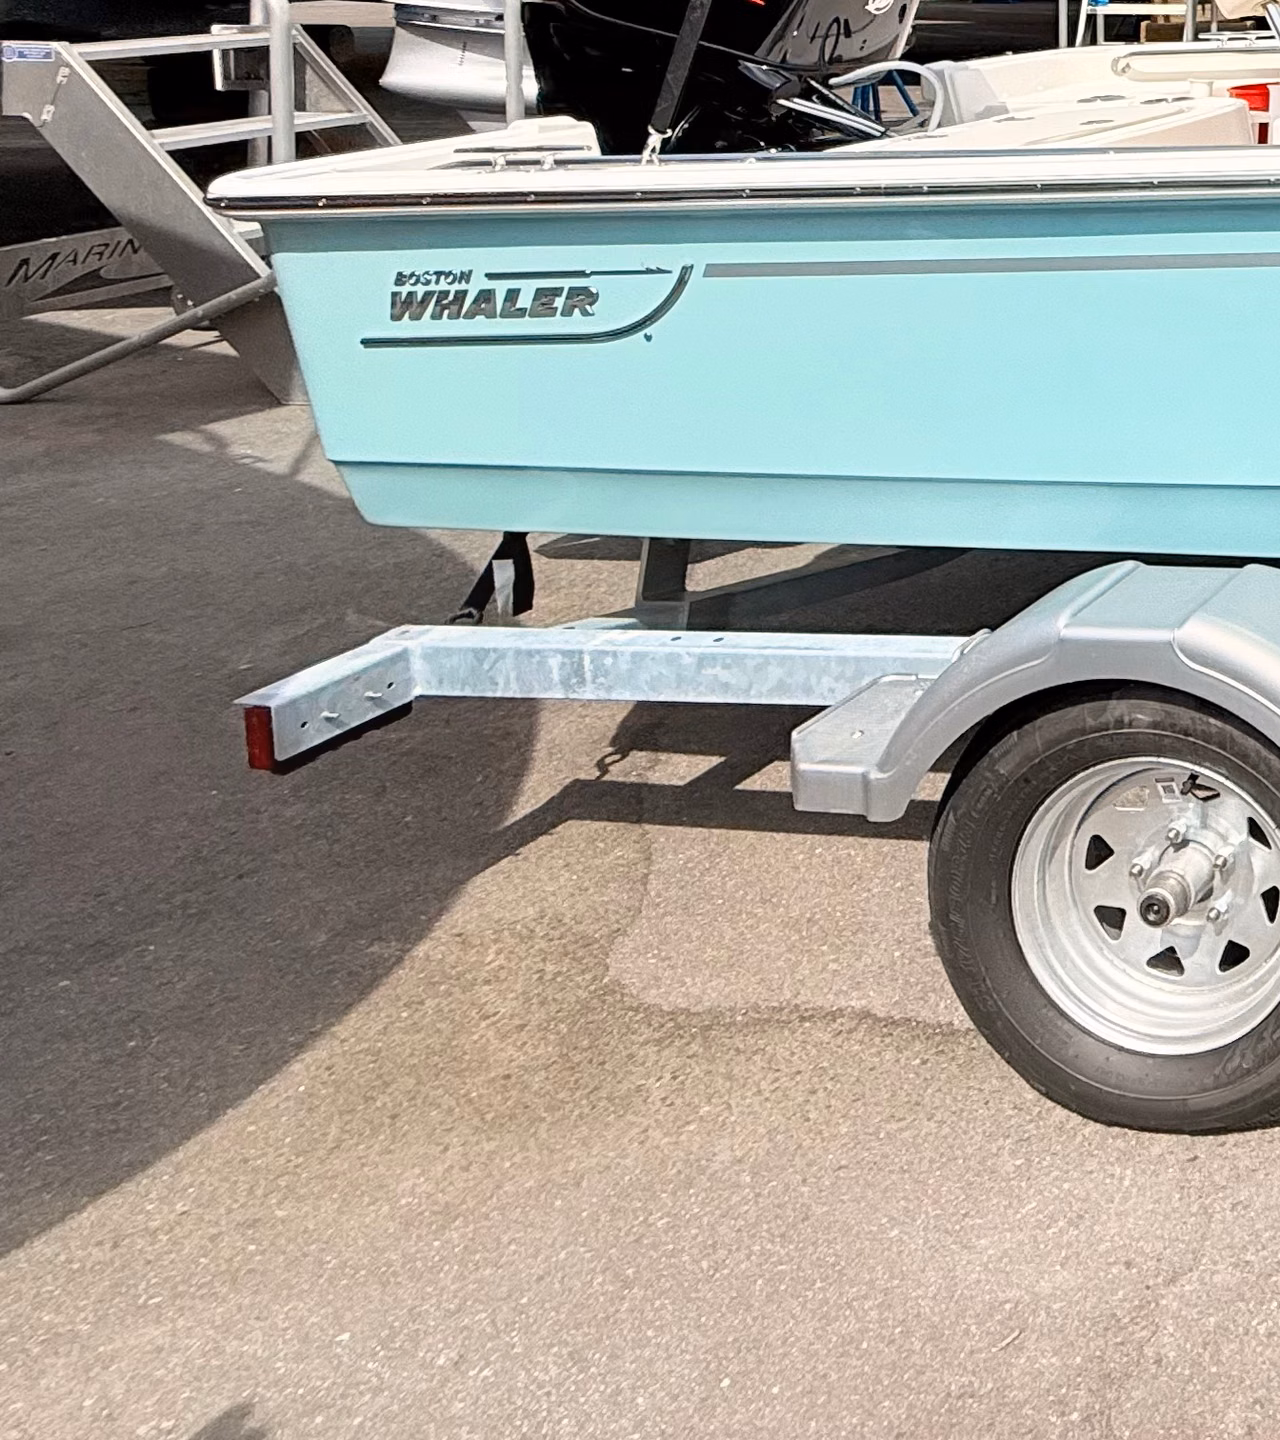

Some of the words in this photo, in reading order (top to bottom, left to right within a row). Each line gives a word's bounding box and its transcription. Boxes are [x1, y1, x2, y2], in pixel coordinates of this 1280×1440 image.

[5, 238, 142, 288] MARIN
[393, 269, 474, 287] BOSTON
[390, 286, 600, 322] WHALER
